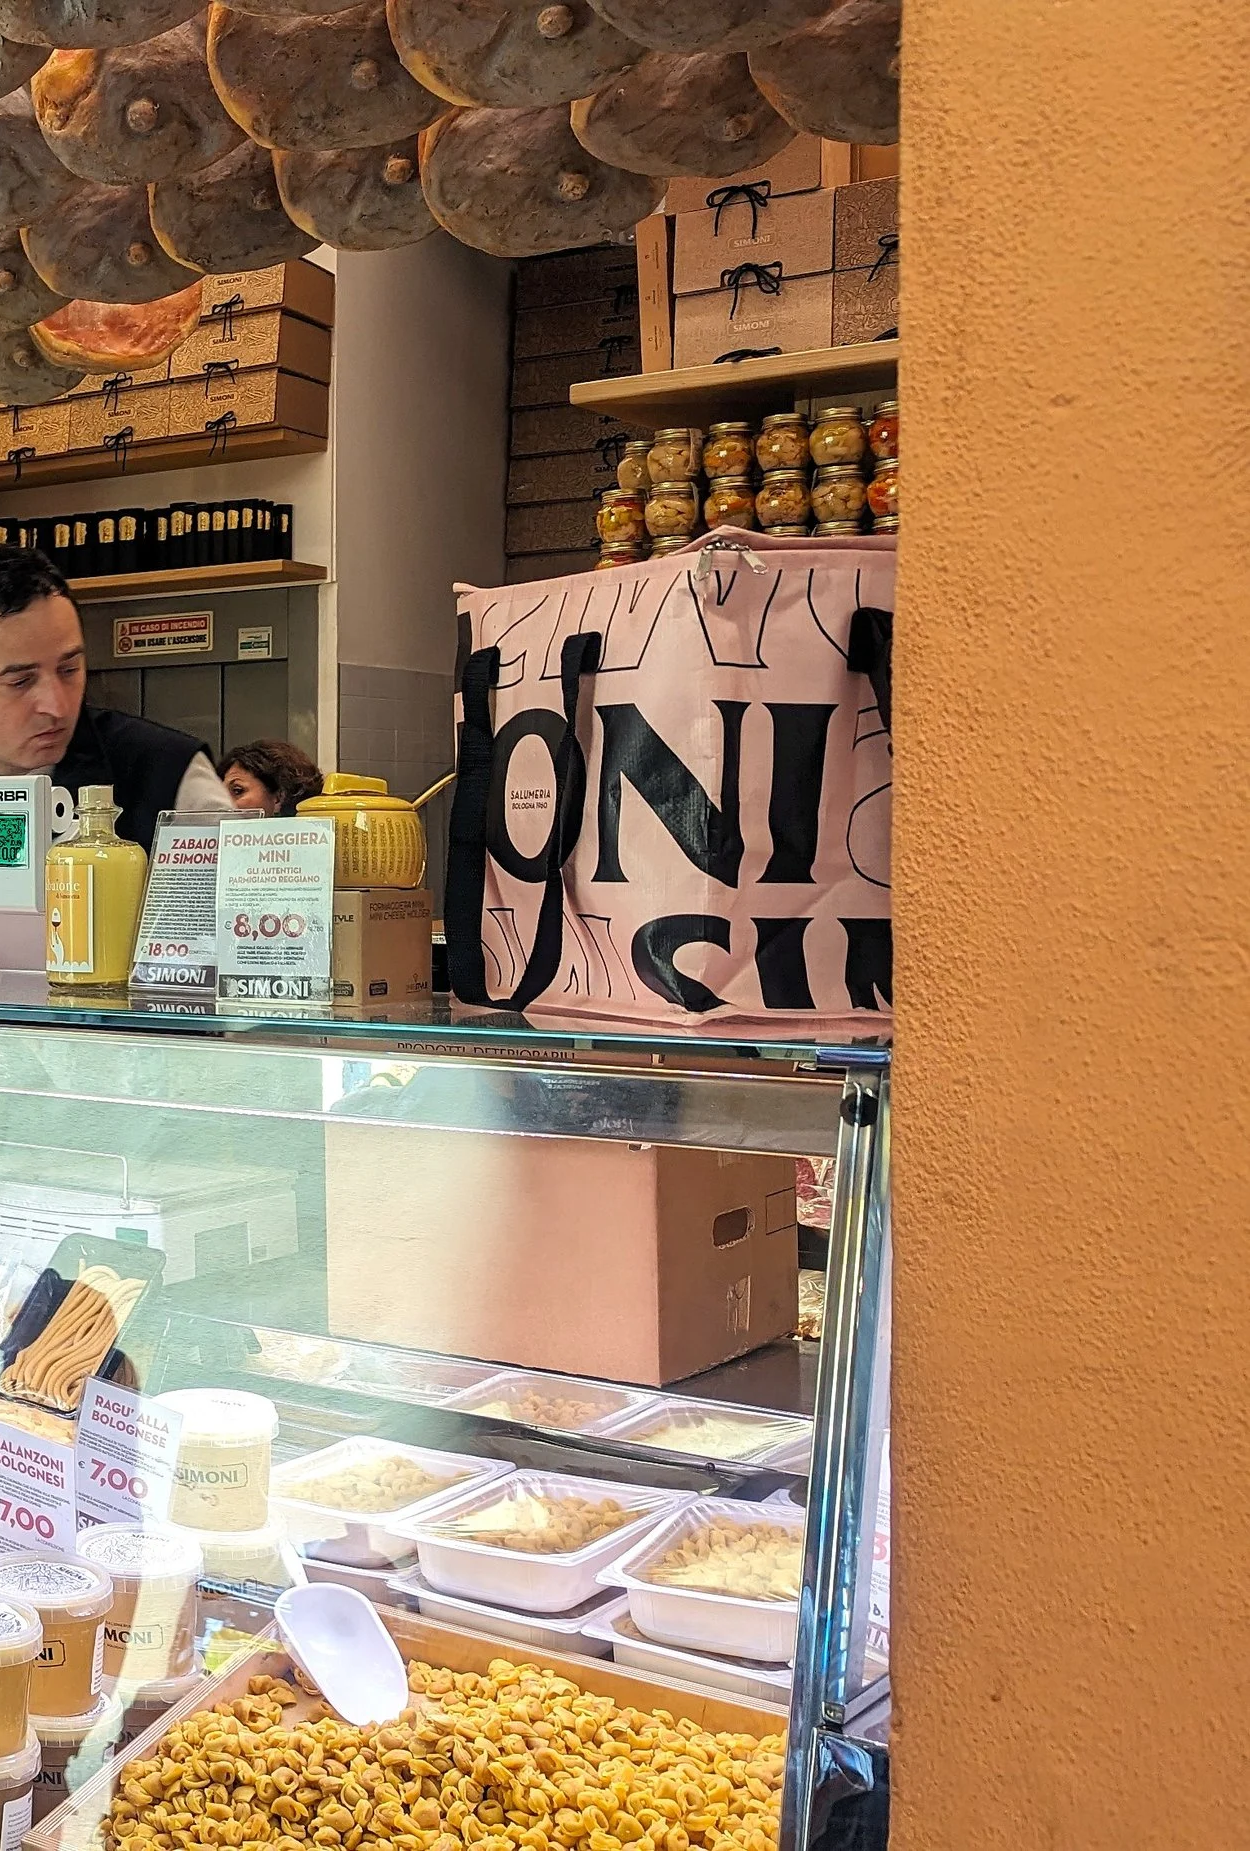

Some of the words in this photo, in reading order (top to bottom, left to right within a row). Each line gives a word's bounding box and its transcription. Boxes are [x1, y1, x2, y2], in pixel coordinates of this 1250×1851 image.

[732, 234, 772, 247] SIMONI
[216, 276, 244, 286] SIMONI
[732, 320, 772, 333] SIMONI
[209, 393, 236, 403] SIMONI
[131, 625, 139, 633] IN
[140, 624, 160, 633] CASO
[161, 623, 170, 631] DI
[170, 619, 206, 630] INCENDIO
[133, 638, 147, 648] NON
[167, 633, 207, 647] L'ASCENSORE
[486, 699, 840, 889] ONI
[510, 788, 551, 800] SALUMERIA
[512, 802, 535, 810] BOLOGNA
[170, 838, 220, 850] ZABAIO
[223, 832, 329, 847] FORMAGGIERA
[157, 853, 171, 865] DI
[172, 853, 219, 865] SIMONE
[258, 849, 291, 864] MINI
[246, 867, 260, 875] GLI
[260, 866, 302, 875] AUTENTICI
[228, 875, 277, 885] PARMIGIANO
[278, 875, 321, 884] REGGIANO
[369, 901, 412, 912] FORMAGGIERA
[333, 914, 354, 923] TYLE
[383, 910, 406, 920] CHEESE
[406, 908, 430, 919] HOLDER
[233, 913, 306, 941] 8,00
[147, 942, 190, 959] 18,00
[146, 966, 207, 985] SIMONI
[236, 979, 310, 998] SIMONI
[94, 1394, 135, 1418] RAGU'
[136, 1412, 170, 1435] ALLA
[91, 1409, 167, 1449] BOLOGNESE
[89, 1457, 149, 1500] 7,00
[175, 1467, 239, 1484] SIMONI
[104, 1627, 153, 1645] MONI
[32, 1771, 62, 1786] ONI
